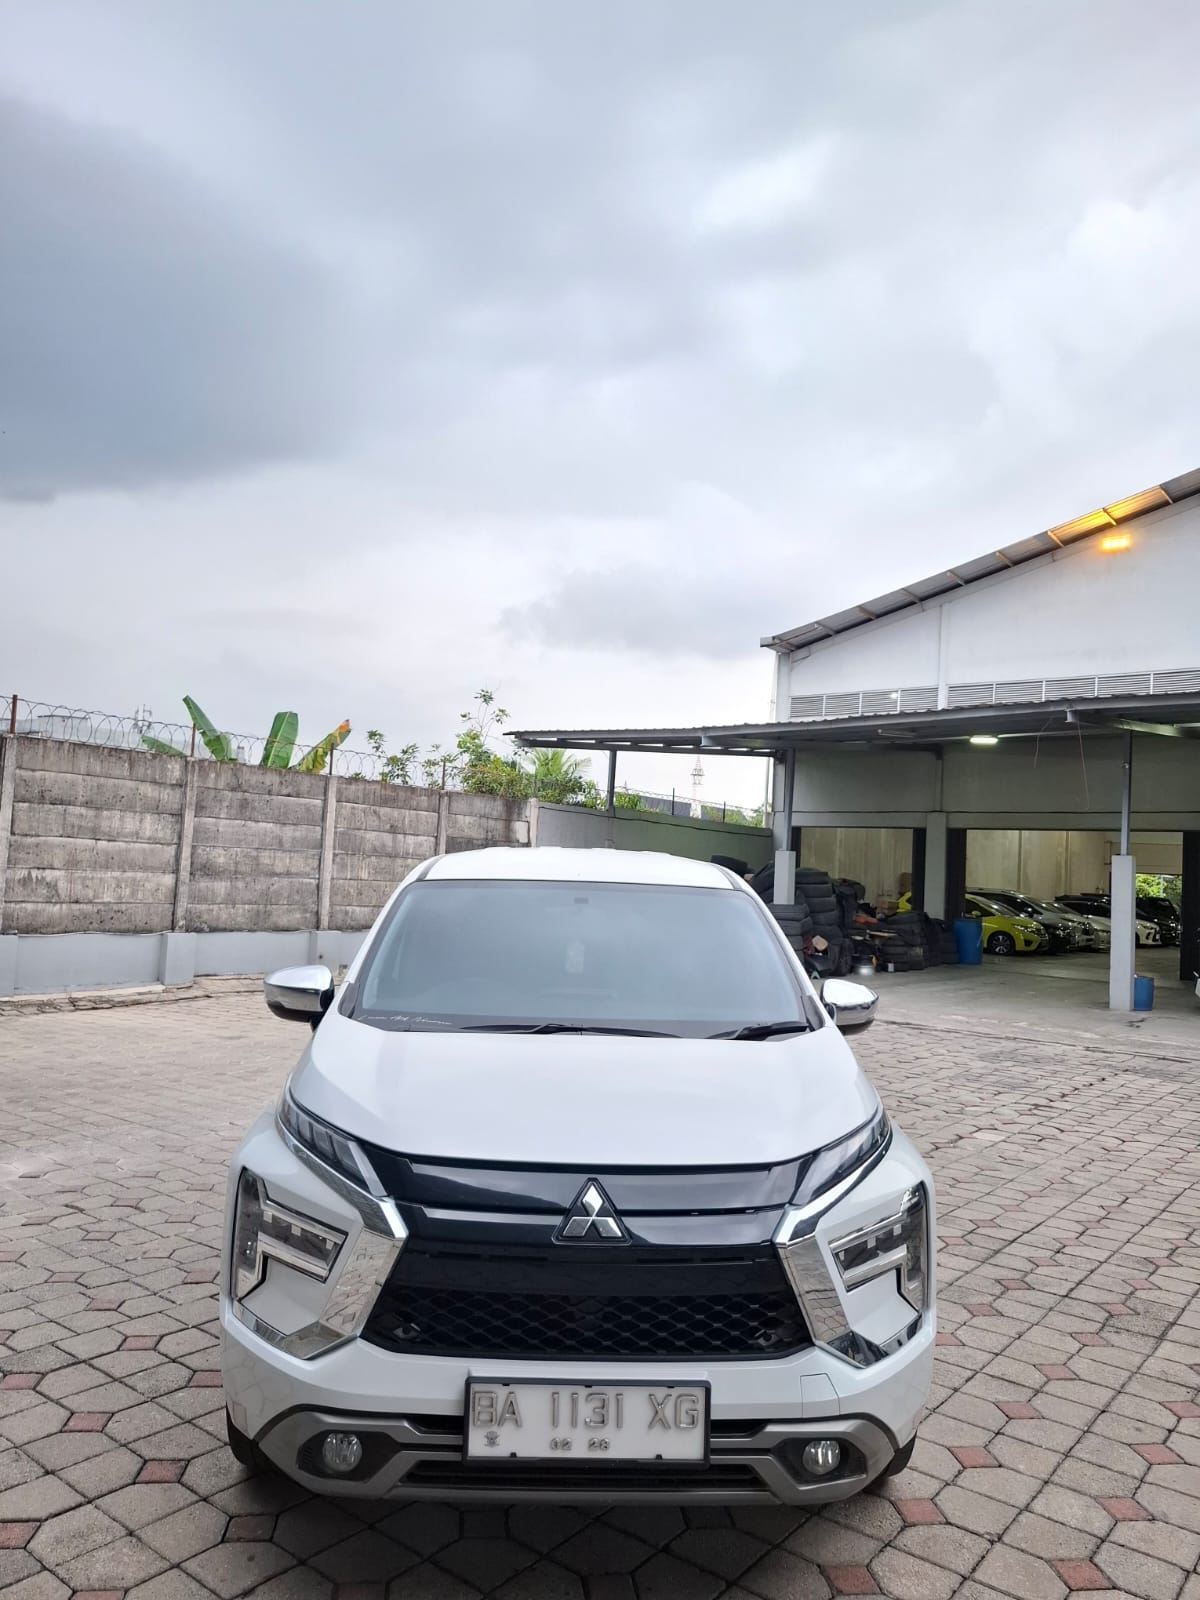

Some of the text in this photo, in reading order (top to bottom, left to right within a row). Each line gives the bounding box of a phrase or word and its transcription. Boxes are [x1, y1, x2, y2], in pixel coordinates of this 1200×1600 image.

[473, 1391, 699, 1430] BA 1131 XG
